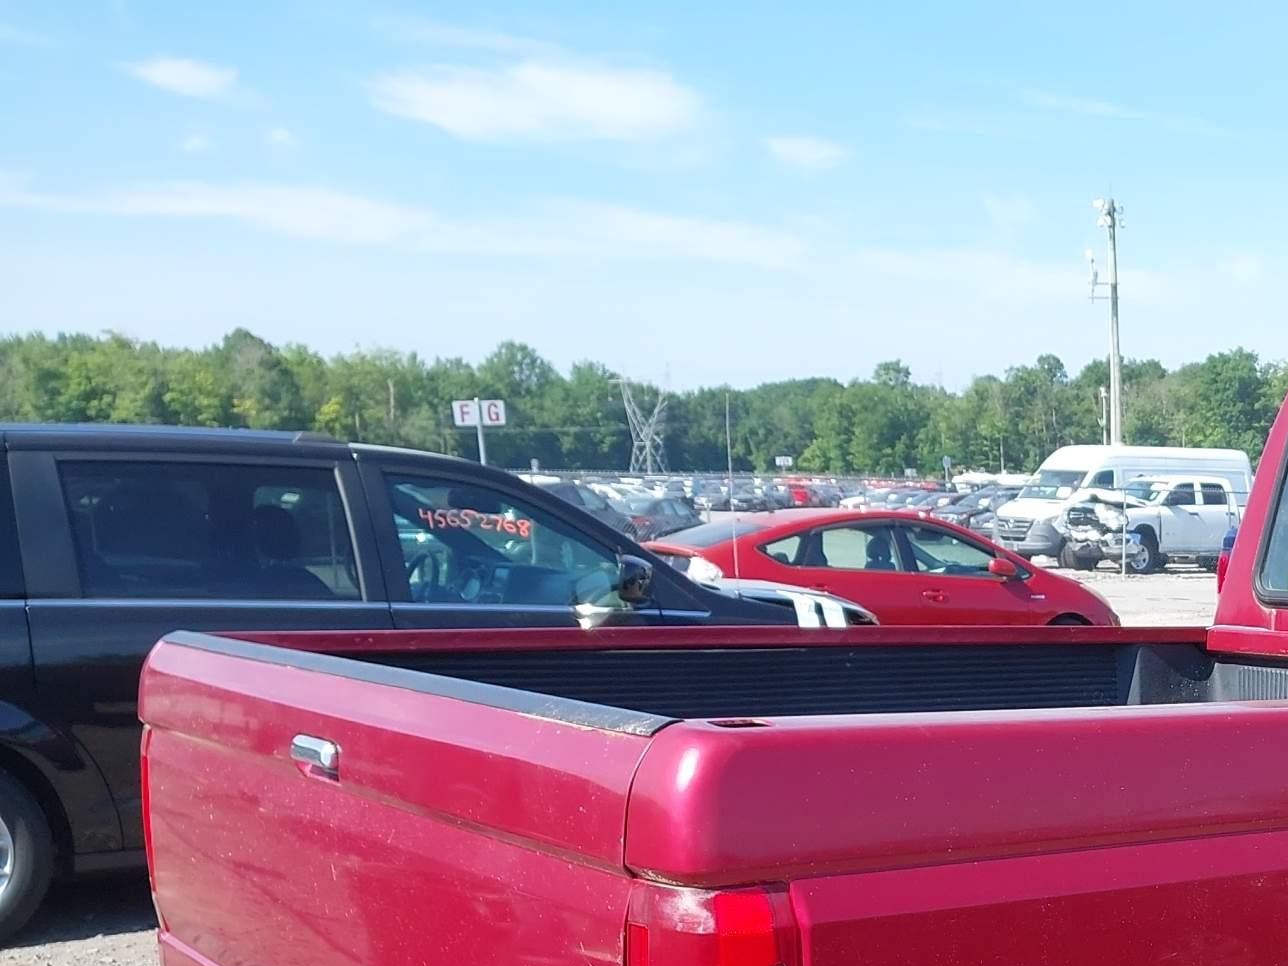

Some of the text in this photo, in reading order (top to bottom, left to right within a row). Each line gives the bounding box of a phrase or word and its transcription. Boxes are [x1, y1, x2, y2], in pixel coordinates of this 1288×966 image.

[460, 404, 471, 423] F
[487, 402, 500, 422] G
[418, 507, 530, 537] 45652768
